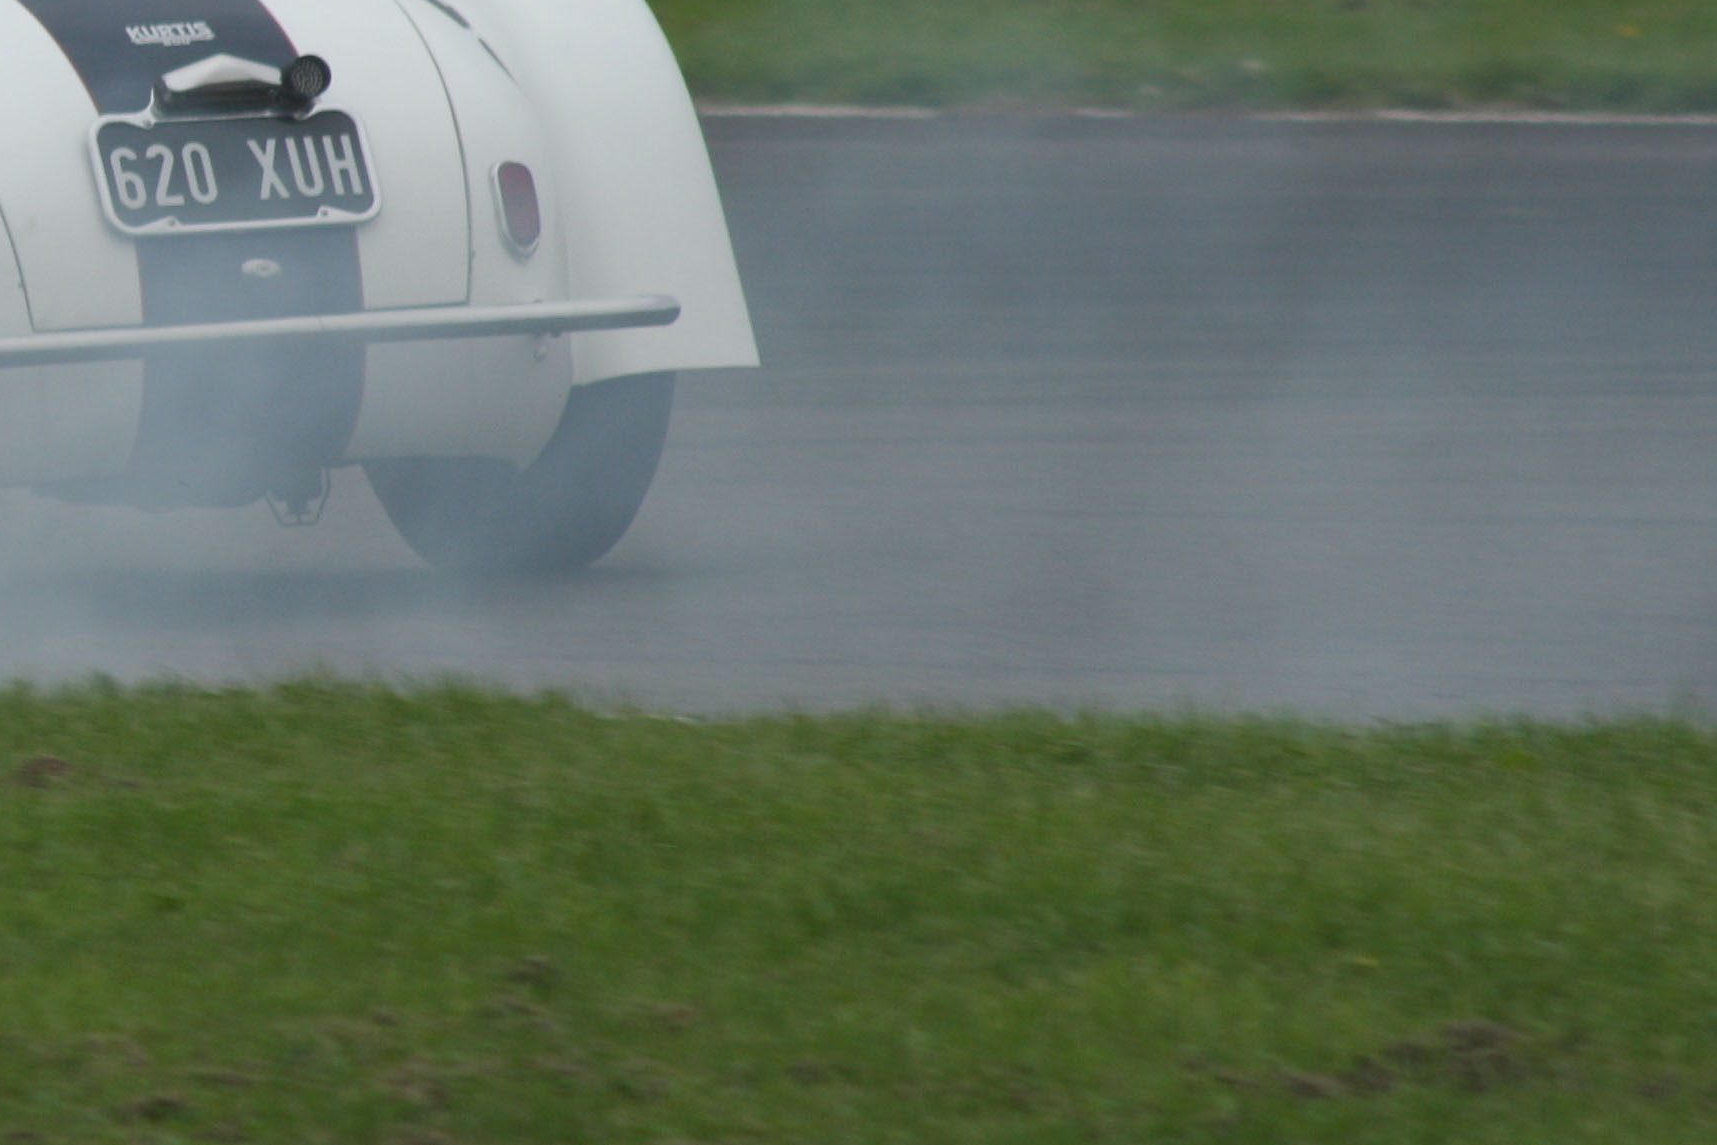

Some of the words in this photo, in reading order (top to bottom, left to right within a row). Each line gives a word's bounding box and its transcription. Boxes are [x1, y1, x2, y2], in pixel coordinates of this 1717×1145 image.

[125, 22, 215, 45] KURTIS
[110, 142, 218, 209] 620
[247, 134, 364, 200] XUH
